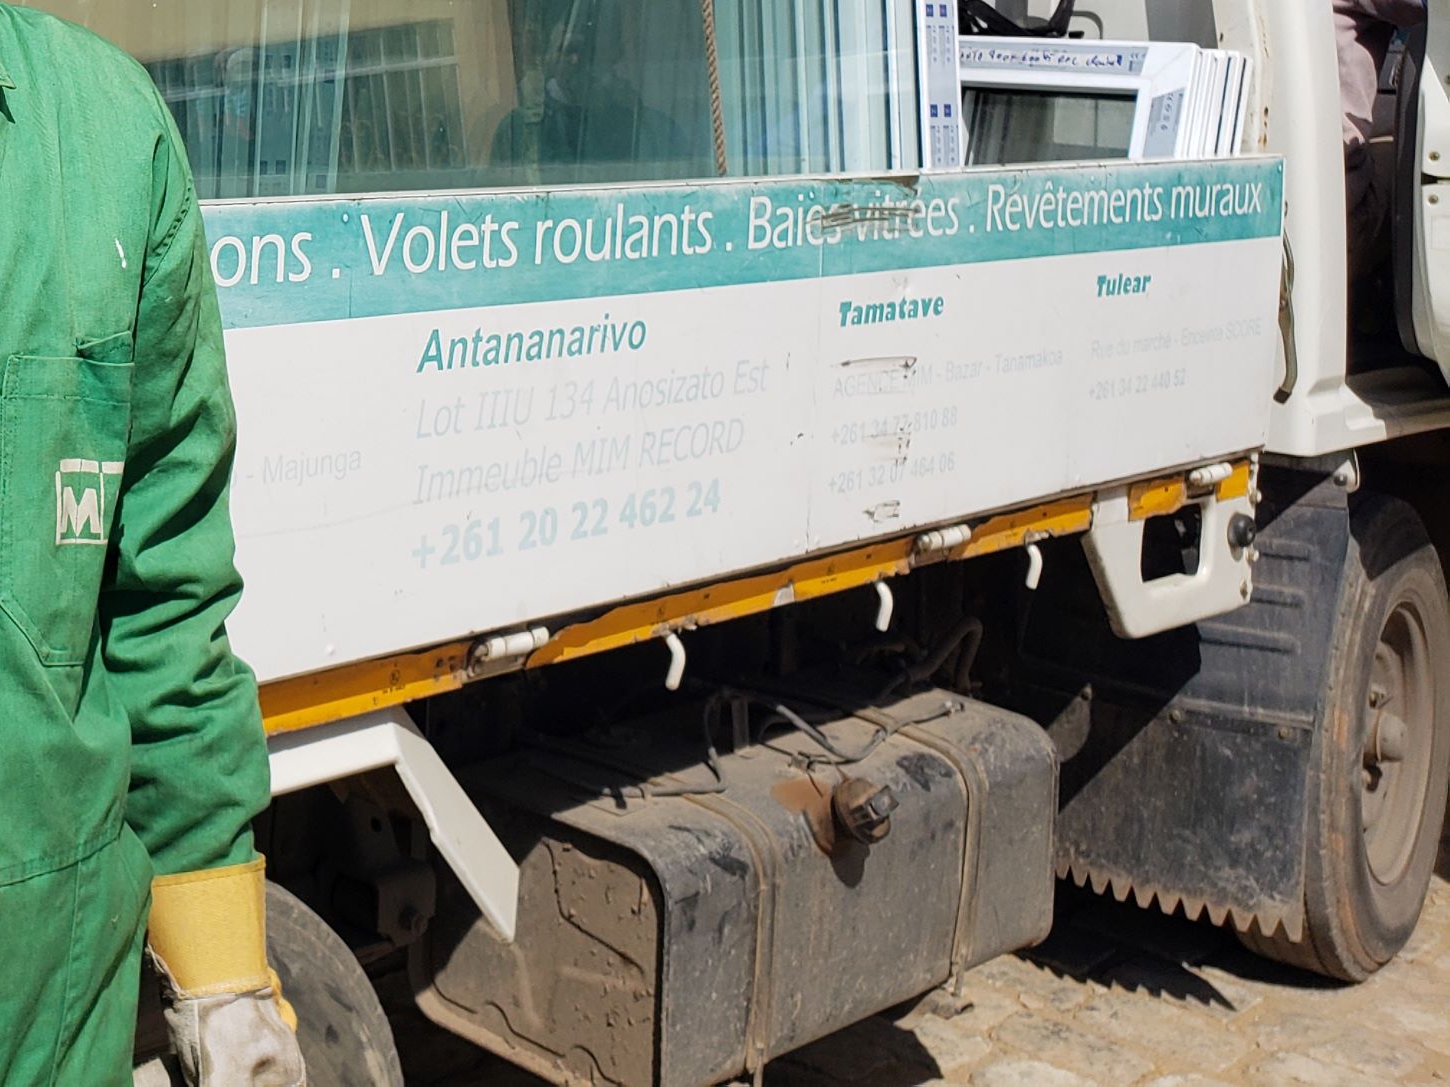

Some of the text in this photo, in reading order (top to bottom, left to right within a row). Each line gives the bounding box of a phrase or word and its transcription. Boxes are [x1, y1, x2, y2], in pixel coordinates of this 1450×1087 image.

[361, 211, 519, 277] Volets
[534, 203, 714, 266] roulants
[986, 180, 1164, 233] Révêtements
[1171, 180, 1262, 220] muraux
[838, 294, 944, 328] Tamatave
[1096, 272, 1152, 298] Tulear
[417, 313, 647, 373] Antananarivo
[945, 360, 983, 383] Bazar
[417, 397, 467, 440] Lot
[545, 378, 595, 422] 134
[604, 365, 726, 414] Anosizato
[732, 359, 771, 395] Est
[261, 447, 362, 488] Majunga
[412, 416, 745, 507] Immeuble MIM RECORD
[410, 476, 722, 570] +261 20 22 462 24
